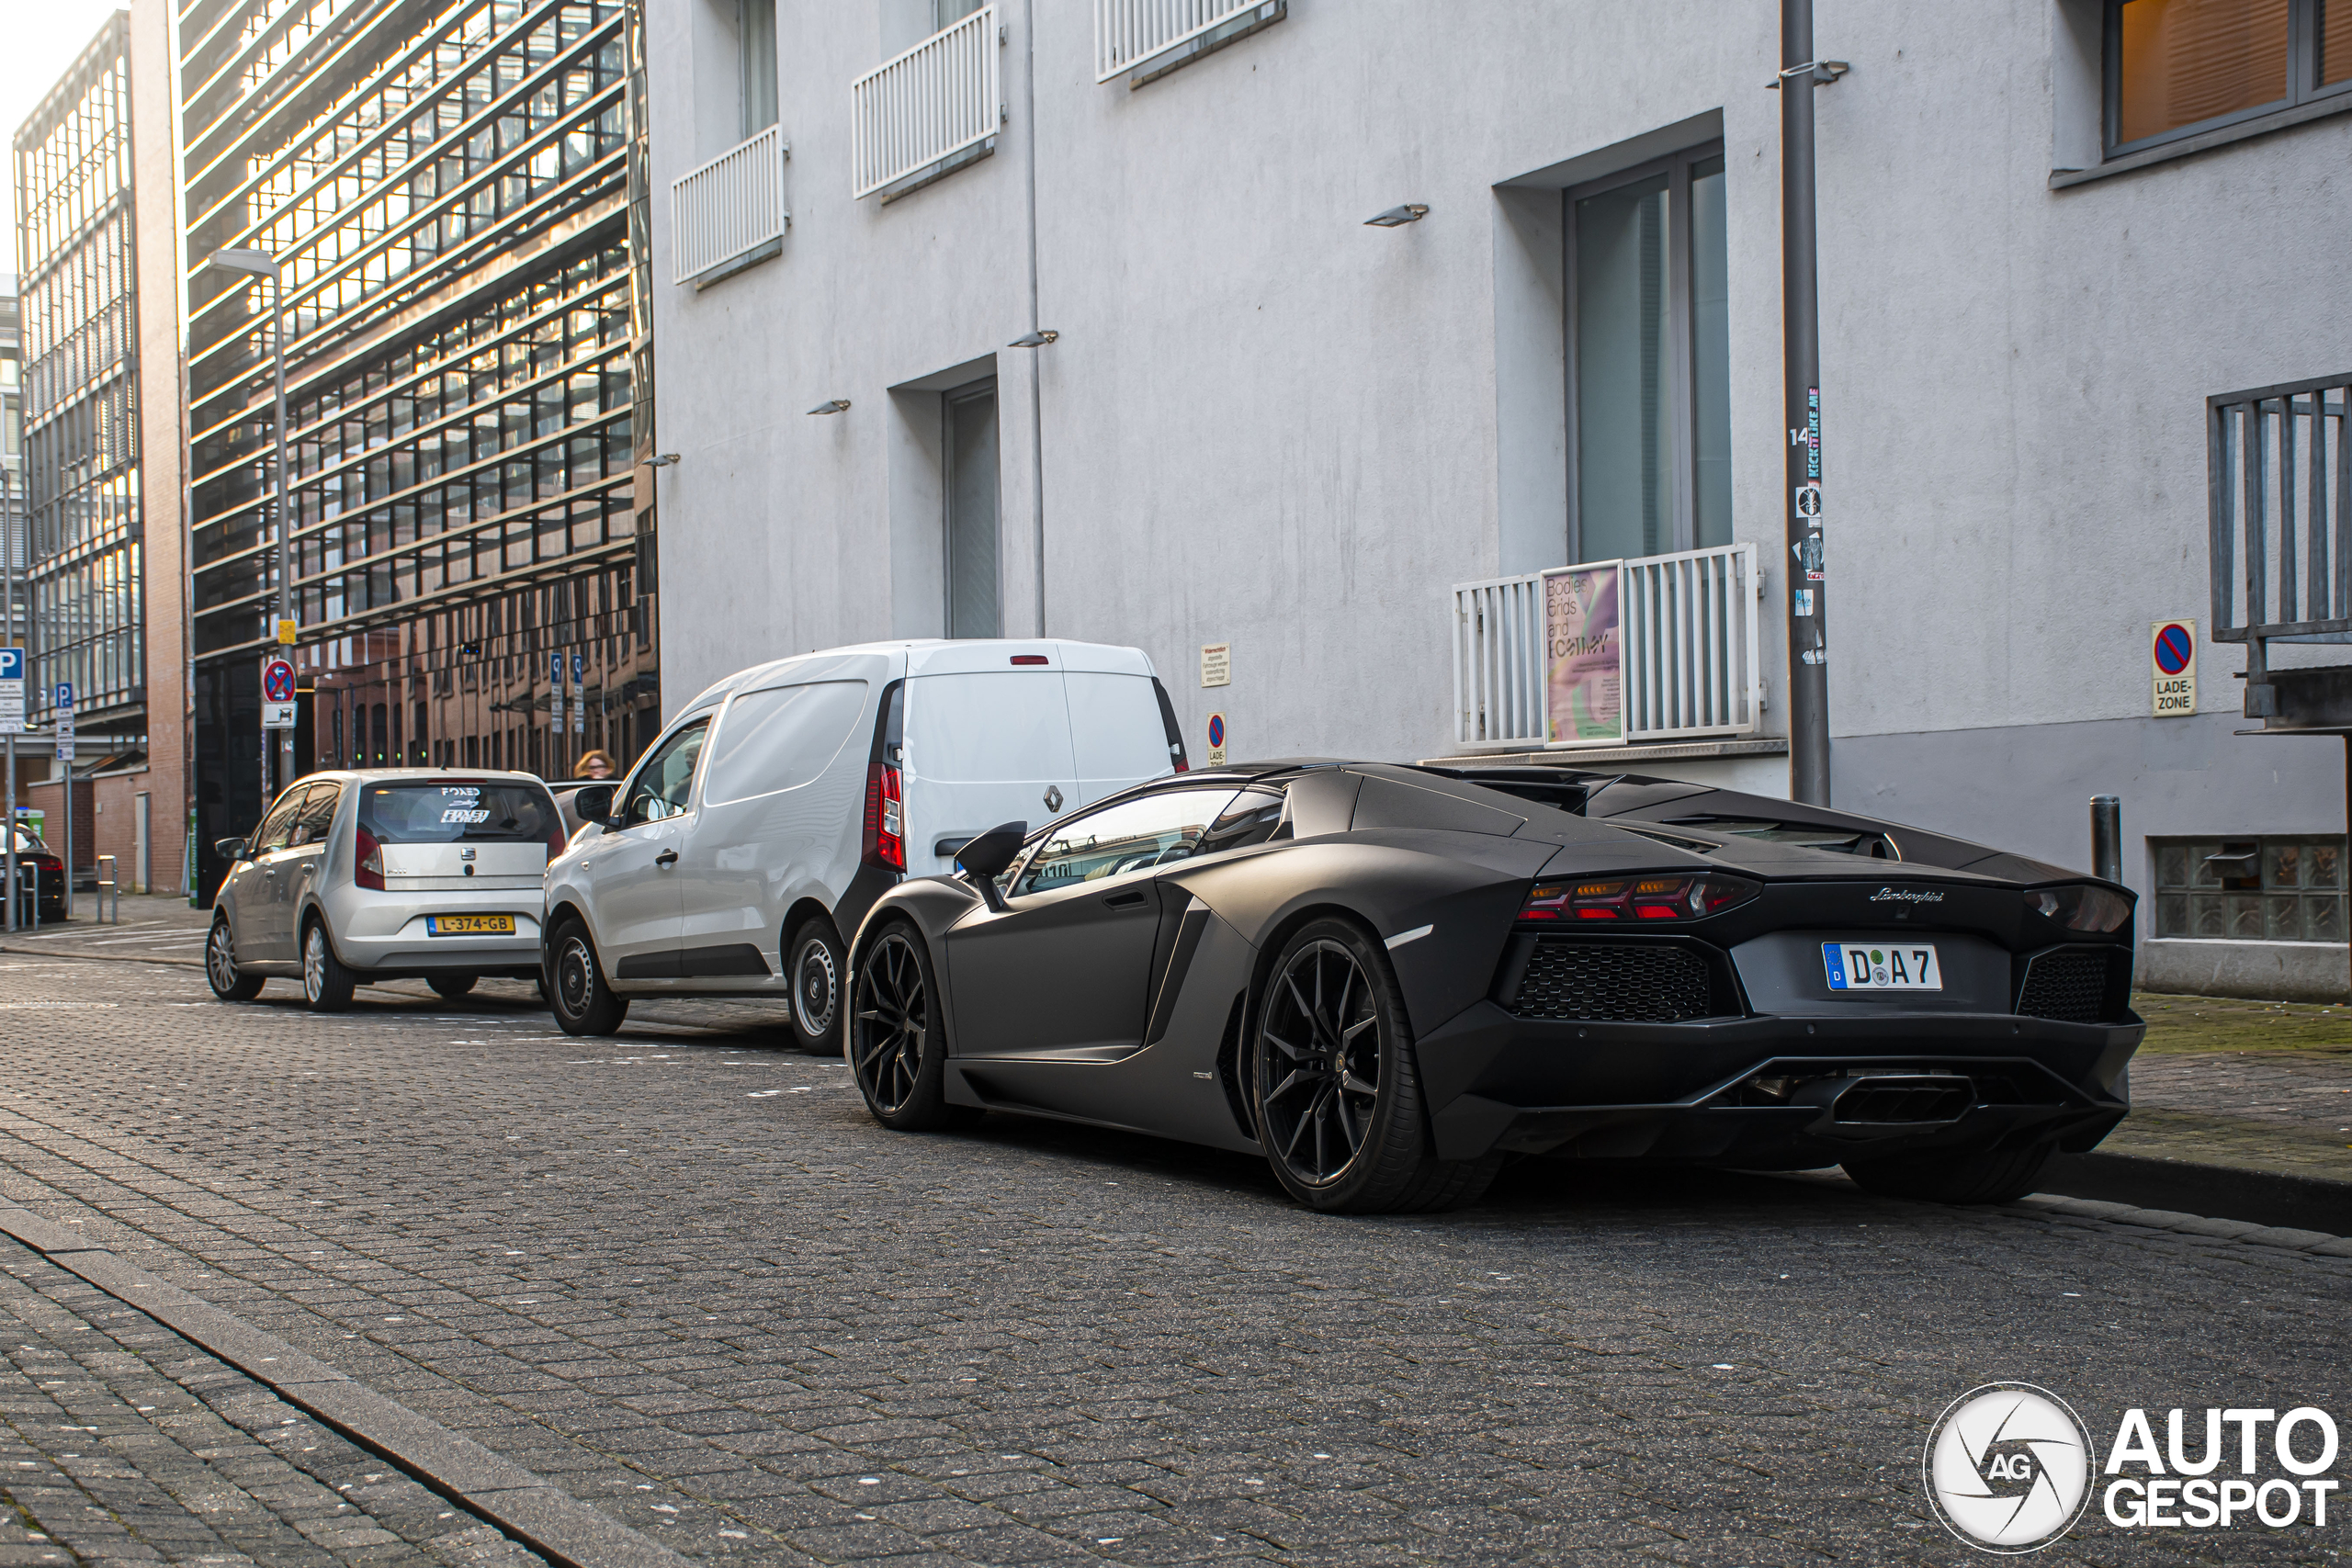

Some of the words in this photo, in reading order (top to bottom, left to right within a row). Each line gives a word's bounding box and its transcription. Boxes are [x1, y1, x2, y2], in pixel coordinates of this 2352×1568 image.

[1790, 427, 1808, 446] 14
[1547, 576, 1589, 597] Bodies,
[1547, 597, 1576, 617] Grids
[1548, 617, 1568, 637] and
[0, 651, 17, 677] P
[59, 685, 70, 707] P
[2156, 681, 2191, 694] LADE-
[2157, 695, 2190, 710] ZONE
[1209, 751, 1225, 761] LADE-
[1870, 887, 1944, 904] Lamborghini
[442, 918, 507, 931] L-374-GB
[1833, 971, 1841, 981] D
[1849, 951, 1871, 984] D
[1890, 950, 1910, 984] A
[1911, 950, 1929, 984] 7
